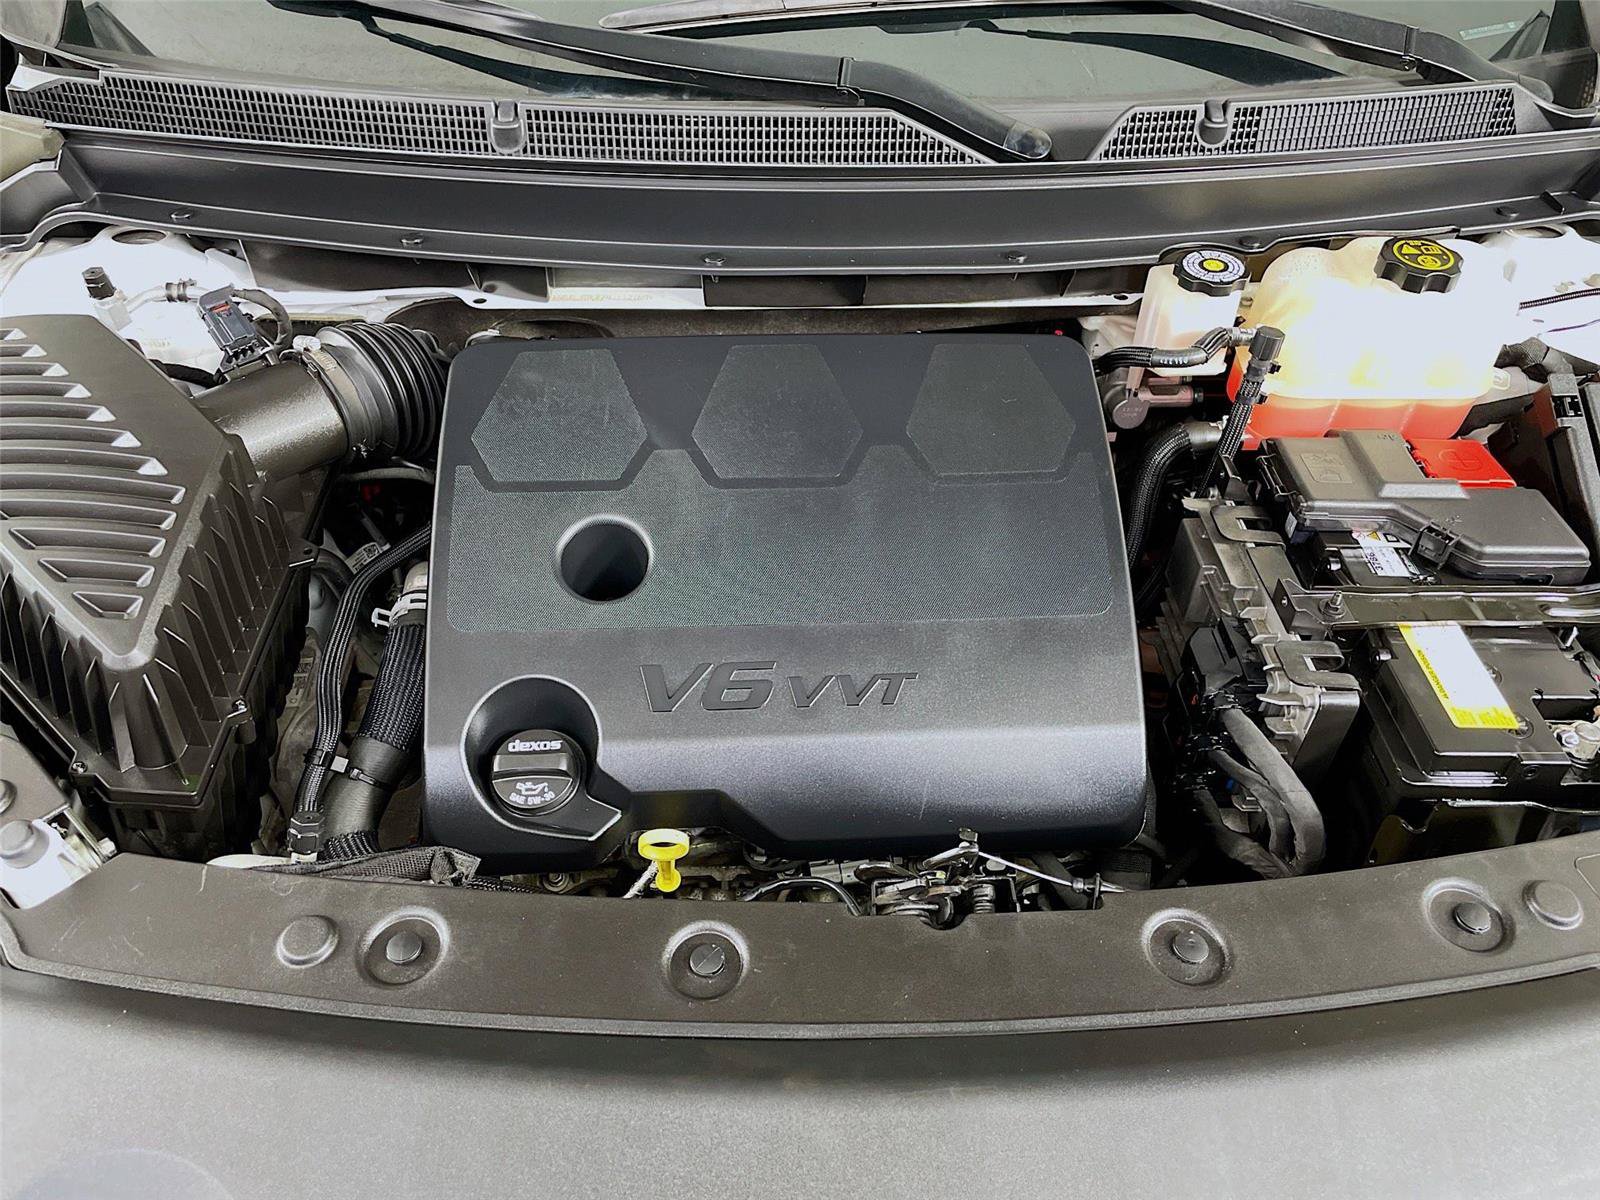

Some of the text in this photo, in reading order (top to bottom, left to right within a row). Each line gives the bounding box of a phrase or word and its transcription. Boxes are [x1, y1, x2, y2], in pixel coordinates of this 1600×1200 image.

[639, 660, 919, 713] V6 VVT
[507, 739, 563, 753] dexos
[509, 791, 556, 805] SAE 5W-30
